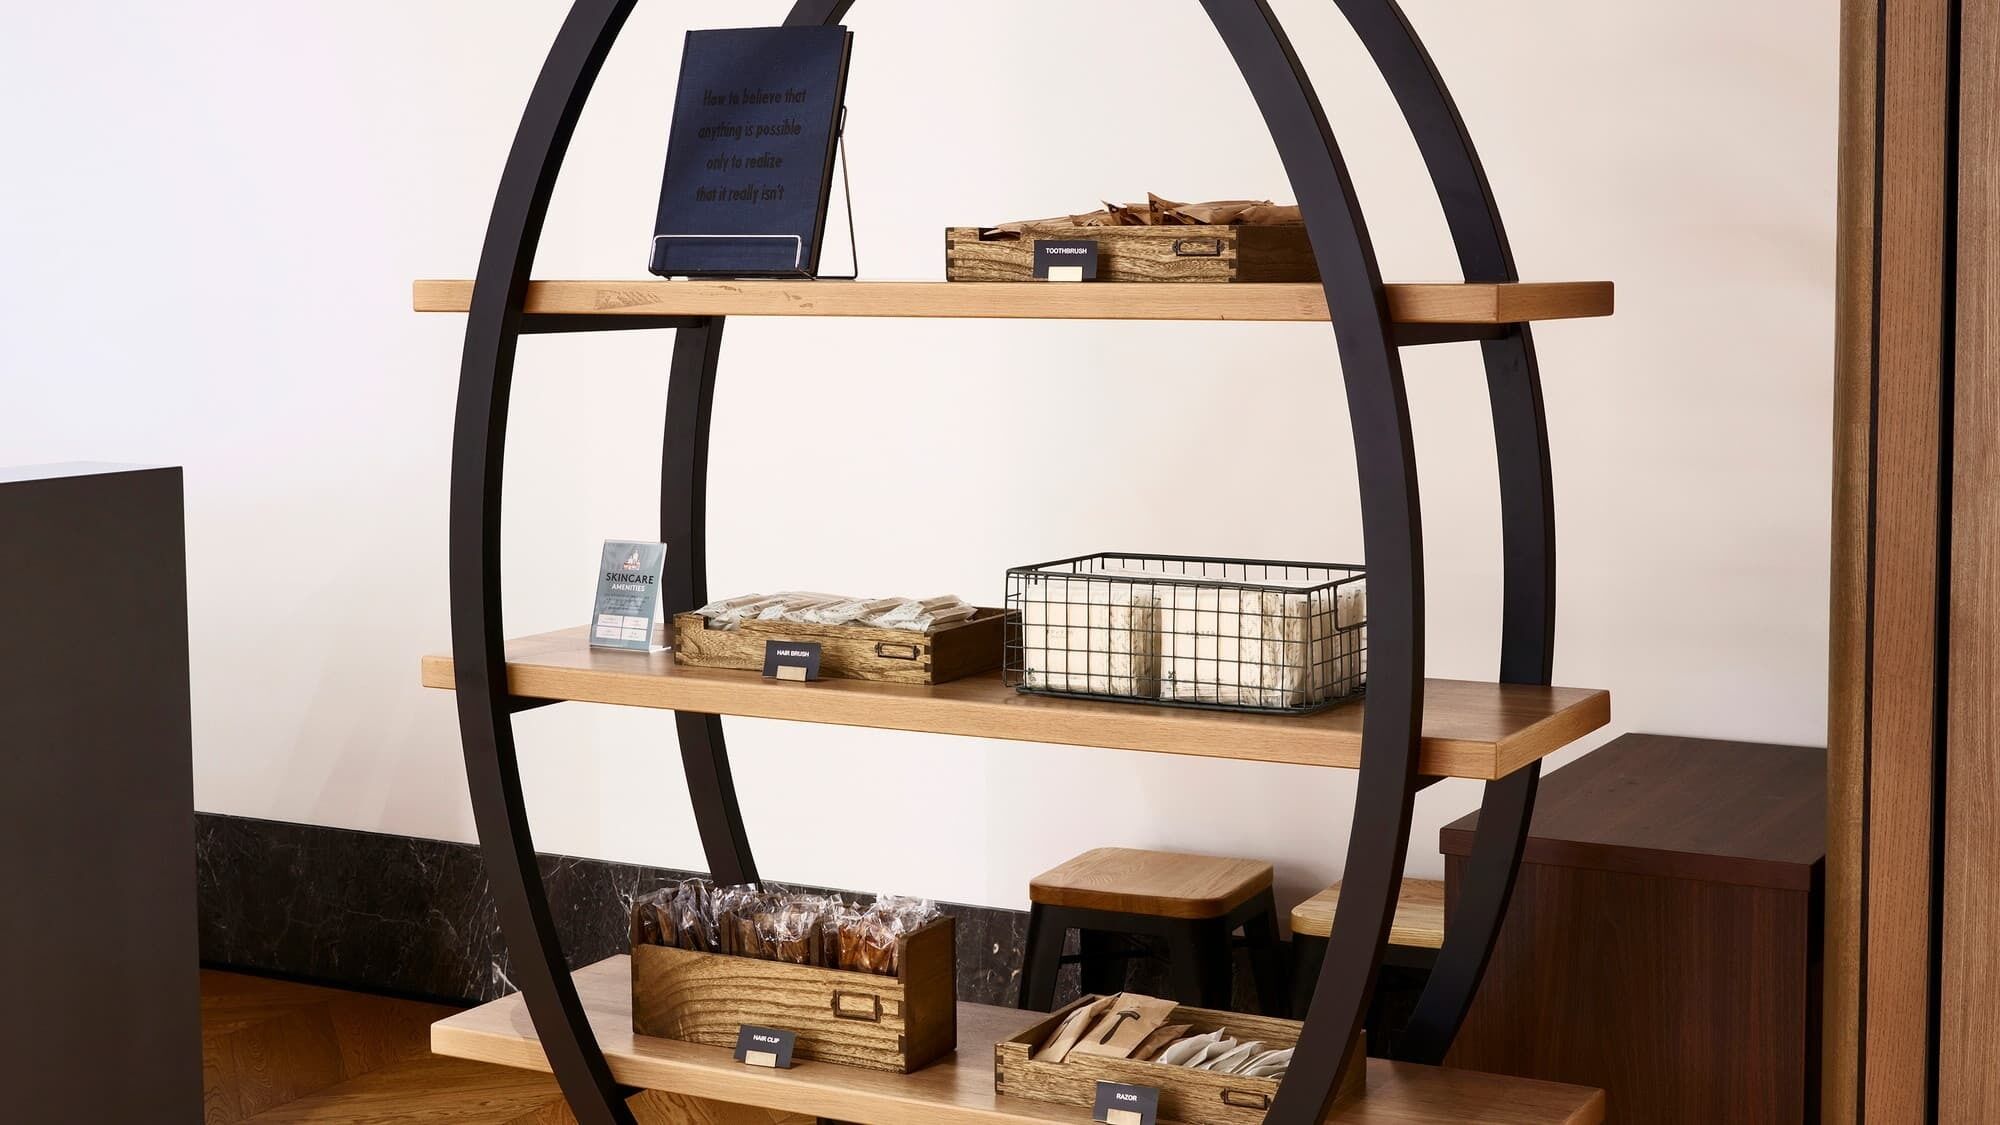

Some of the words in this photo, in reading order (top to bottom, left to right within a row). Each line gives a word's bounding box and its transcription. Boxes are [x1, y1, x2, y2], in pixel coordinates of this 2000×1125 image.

[703, 89, 725, 106] How
[728, 90, 740, 105] to
[742, 88, 782, 105] believe
[784, 88, 807, 104] that
[698, 120, 742, 141] anything
[745, 121, 753, 137] is
[755, 118, 802, 139] possible
[706, 152, 728, 173] only
[731, 154, 741, 169] to
[745, 152, 783, 169] realize
[695, 185, 717, 202] that
[718, 185, 727, 202] it
[728, 184, 758, 204] really
[761, 184, 785, 201] isn't
[1045, 247, 1088, 255] TOOTHBRUSH
[606, 572, 654, 585] SKINCARE
[611, 583, 646, 592] AMENITIES
[753, 1034, 767, 1042] HAIR
[767, 1036, 780, 1044] CLIP
[1116, 1092, 1137, 1102] RAZOR
